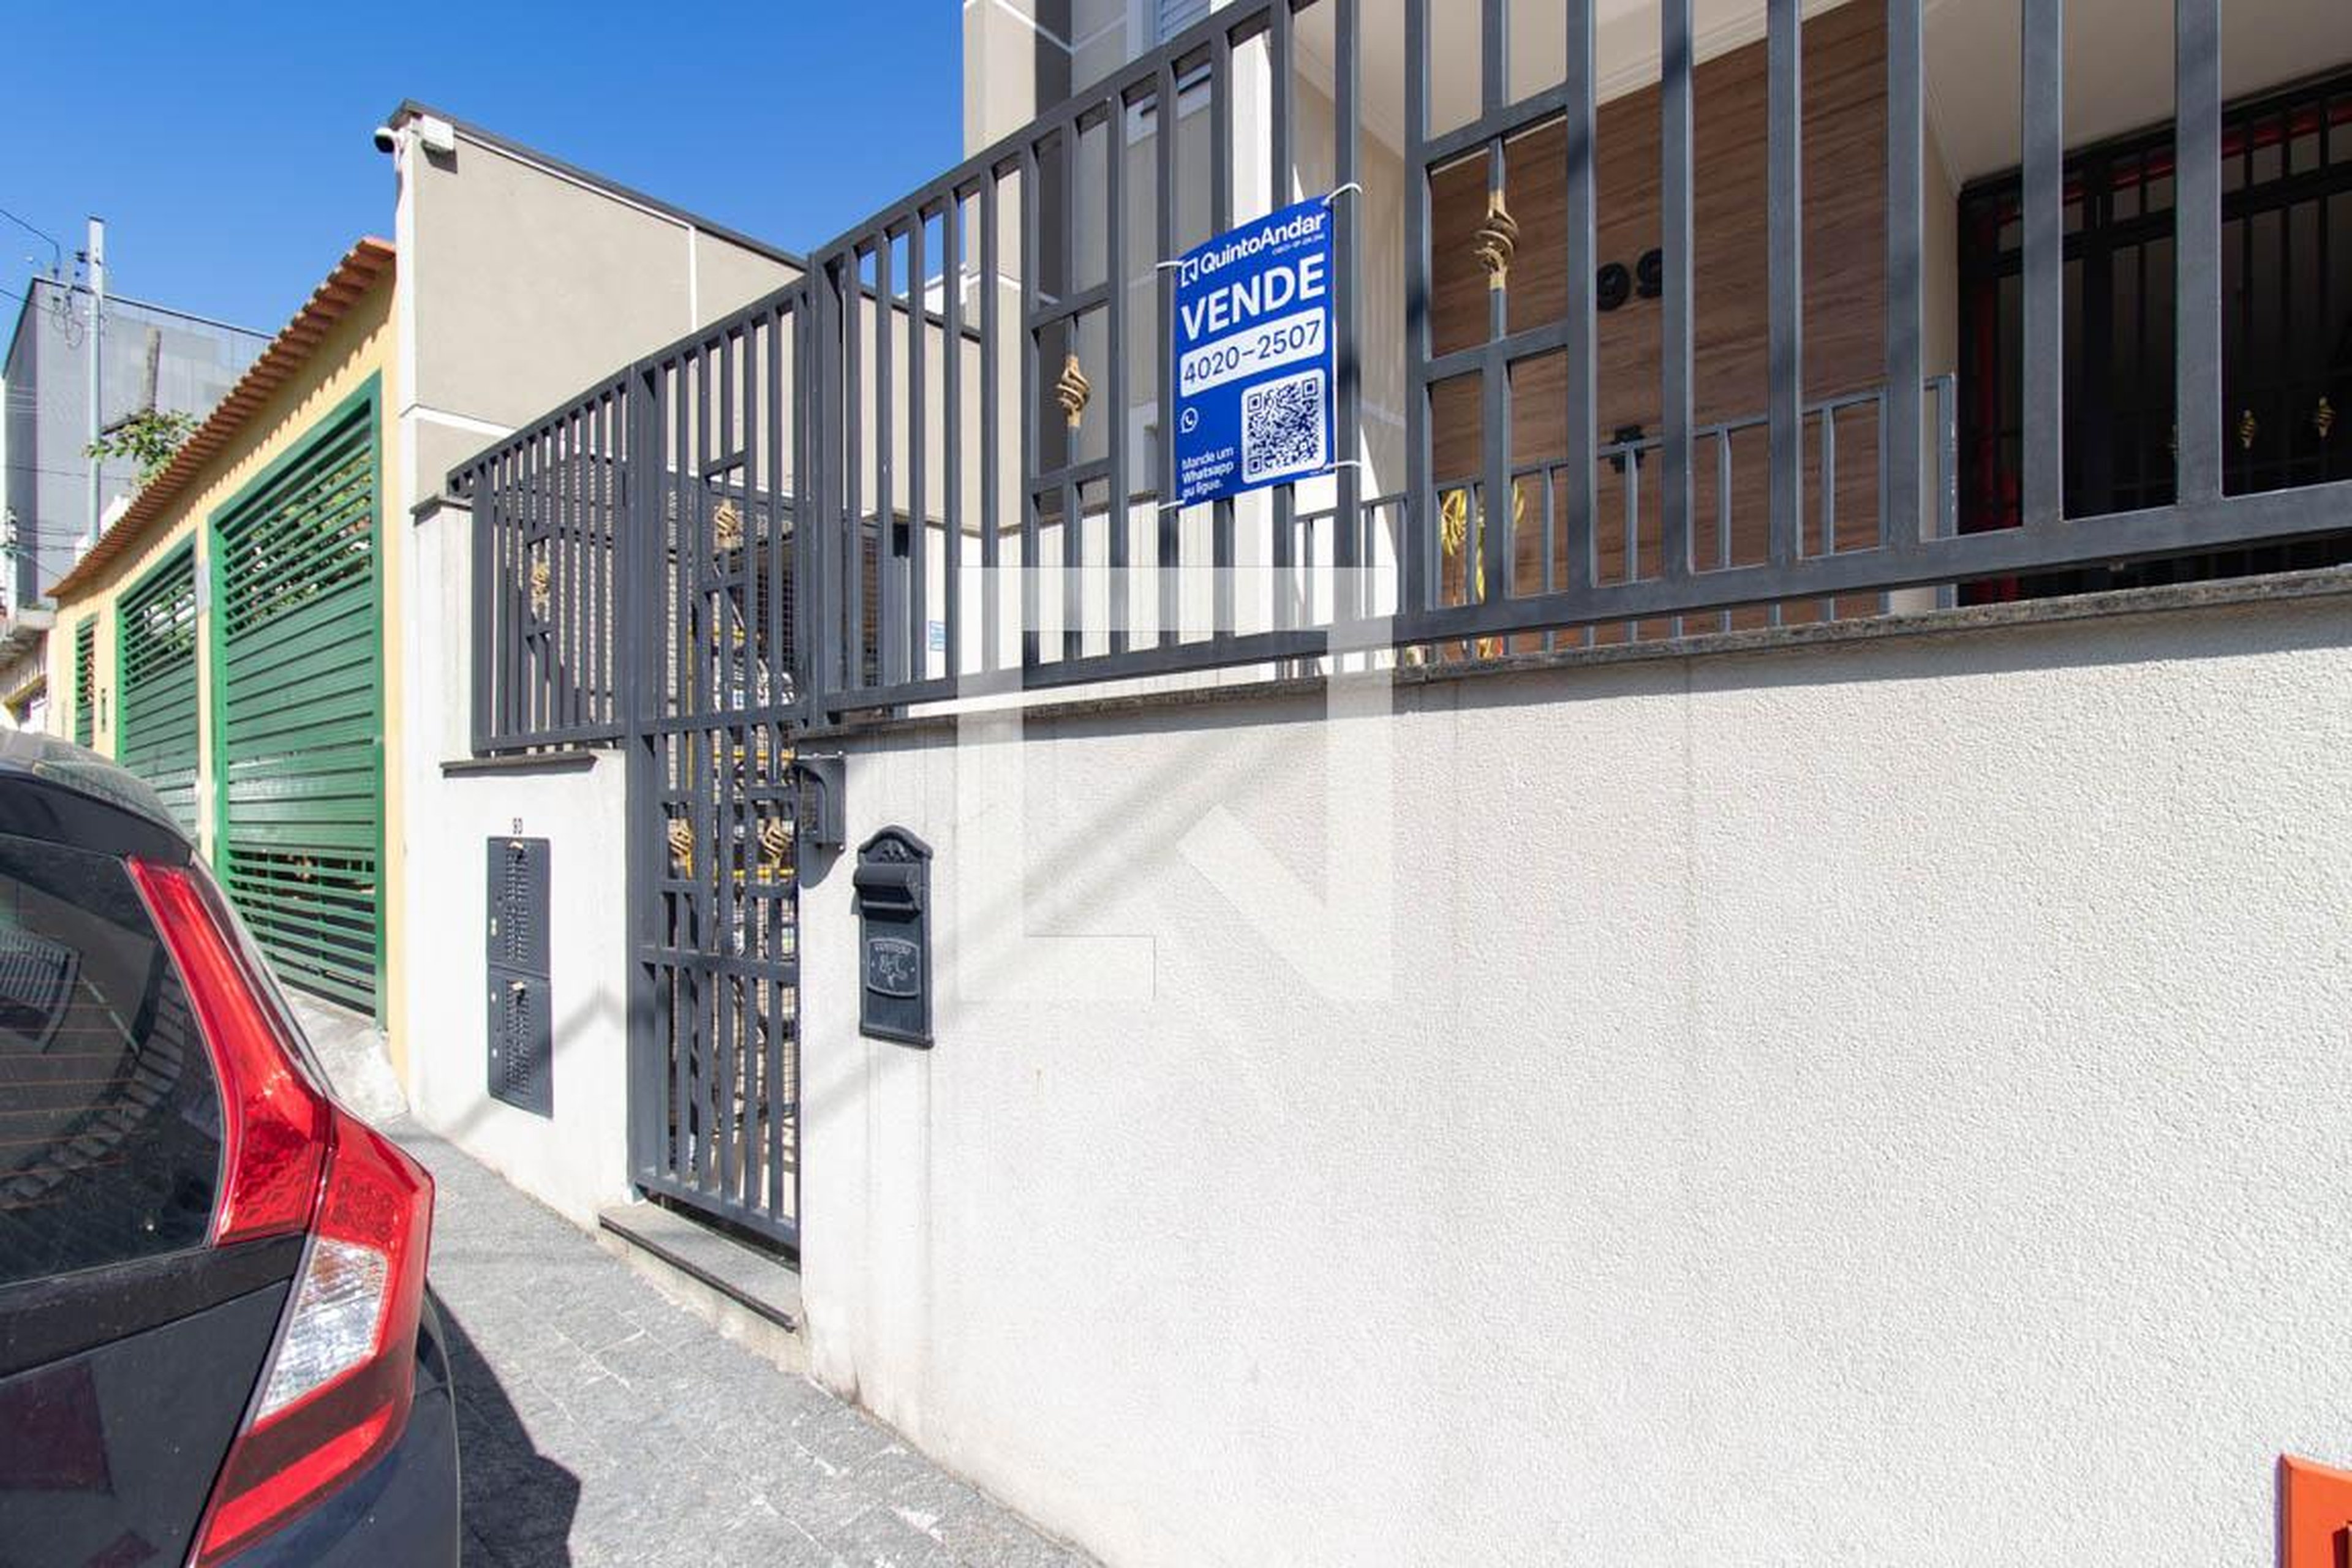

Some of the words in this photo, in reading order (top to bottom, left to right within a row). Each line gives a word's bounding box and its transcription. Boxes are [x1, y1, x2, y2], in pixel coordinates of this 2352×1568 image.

[1200, 213, 1326, 274] QuintoAndar
[1181, 252, 1325, 341] VENDE
[1184, 320, 1321, 383] 4020-2507
[1182, 450, 1215, 471] Mande
[1216, 447, 1234, 460] um
